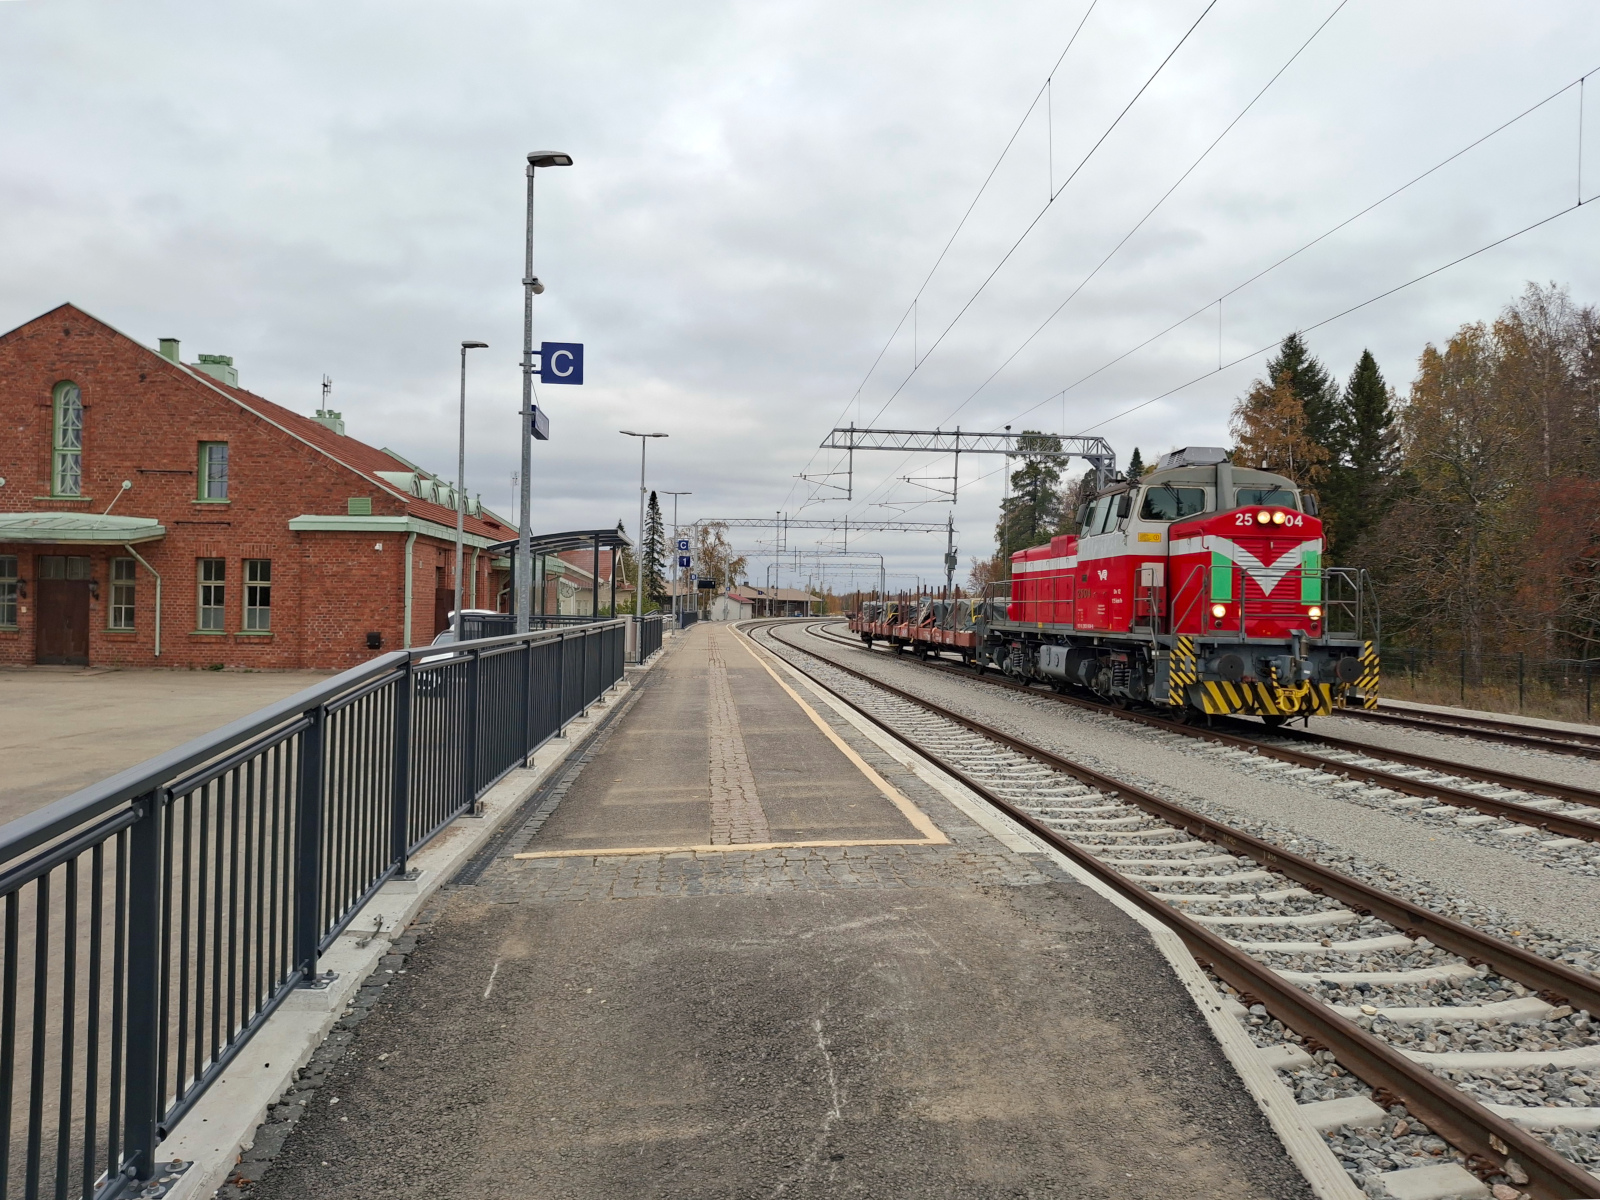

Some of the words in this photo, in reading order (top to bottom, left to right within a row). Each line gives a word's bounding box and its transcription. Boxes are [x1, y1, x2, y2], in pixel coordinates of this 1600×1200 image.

[551, 350, 574, 377] C
[1235, 513, 1253, 526] 25
[1285, 514, 1303, 527] 04
[680, 541, 687, 549] C
[682, 558, 686, 566] 1
[1097, 570, 1108, 580] VR
